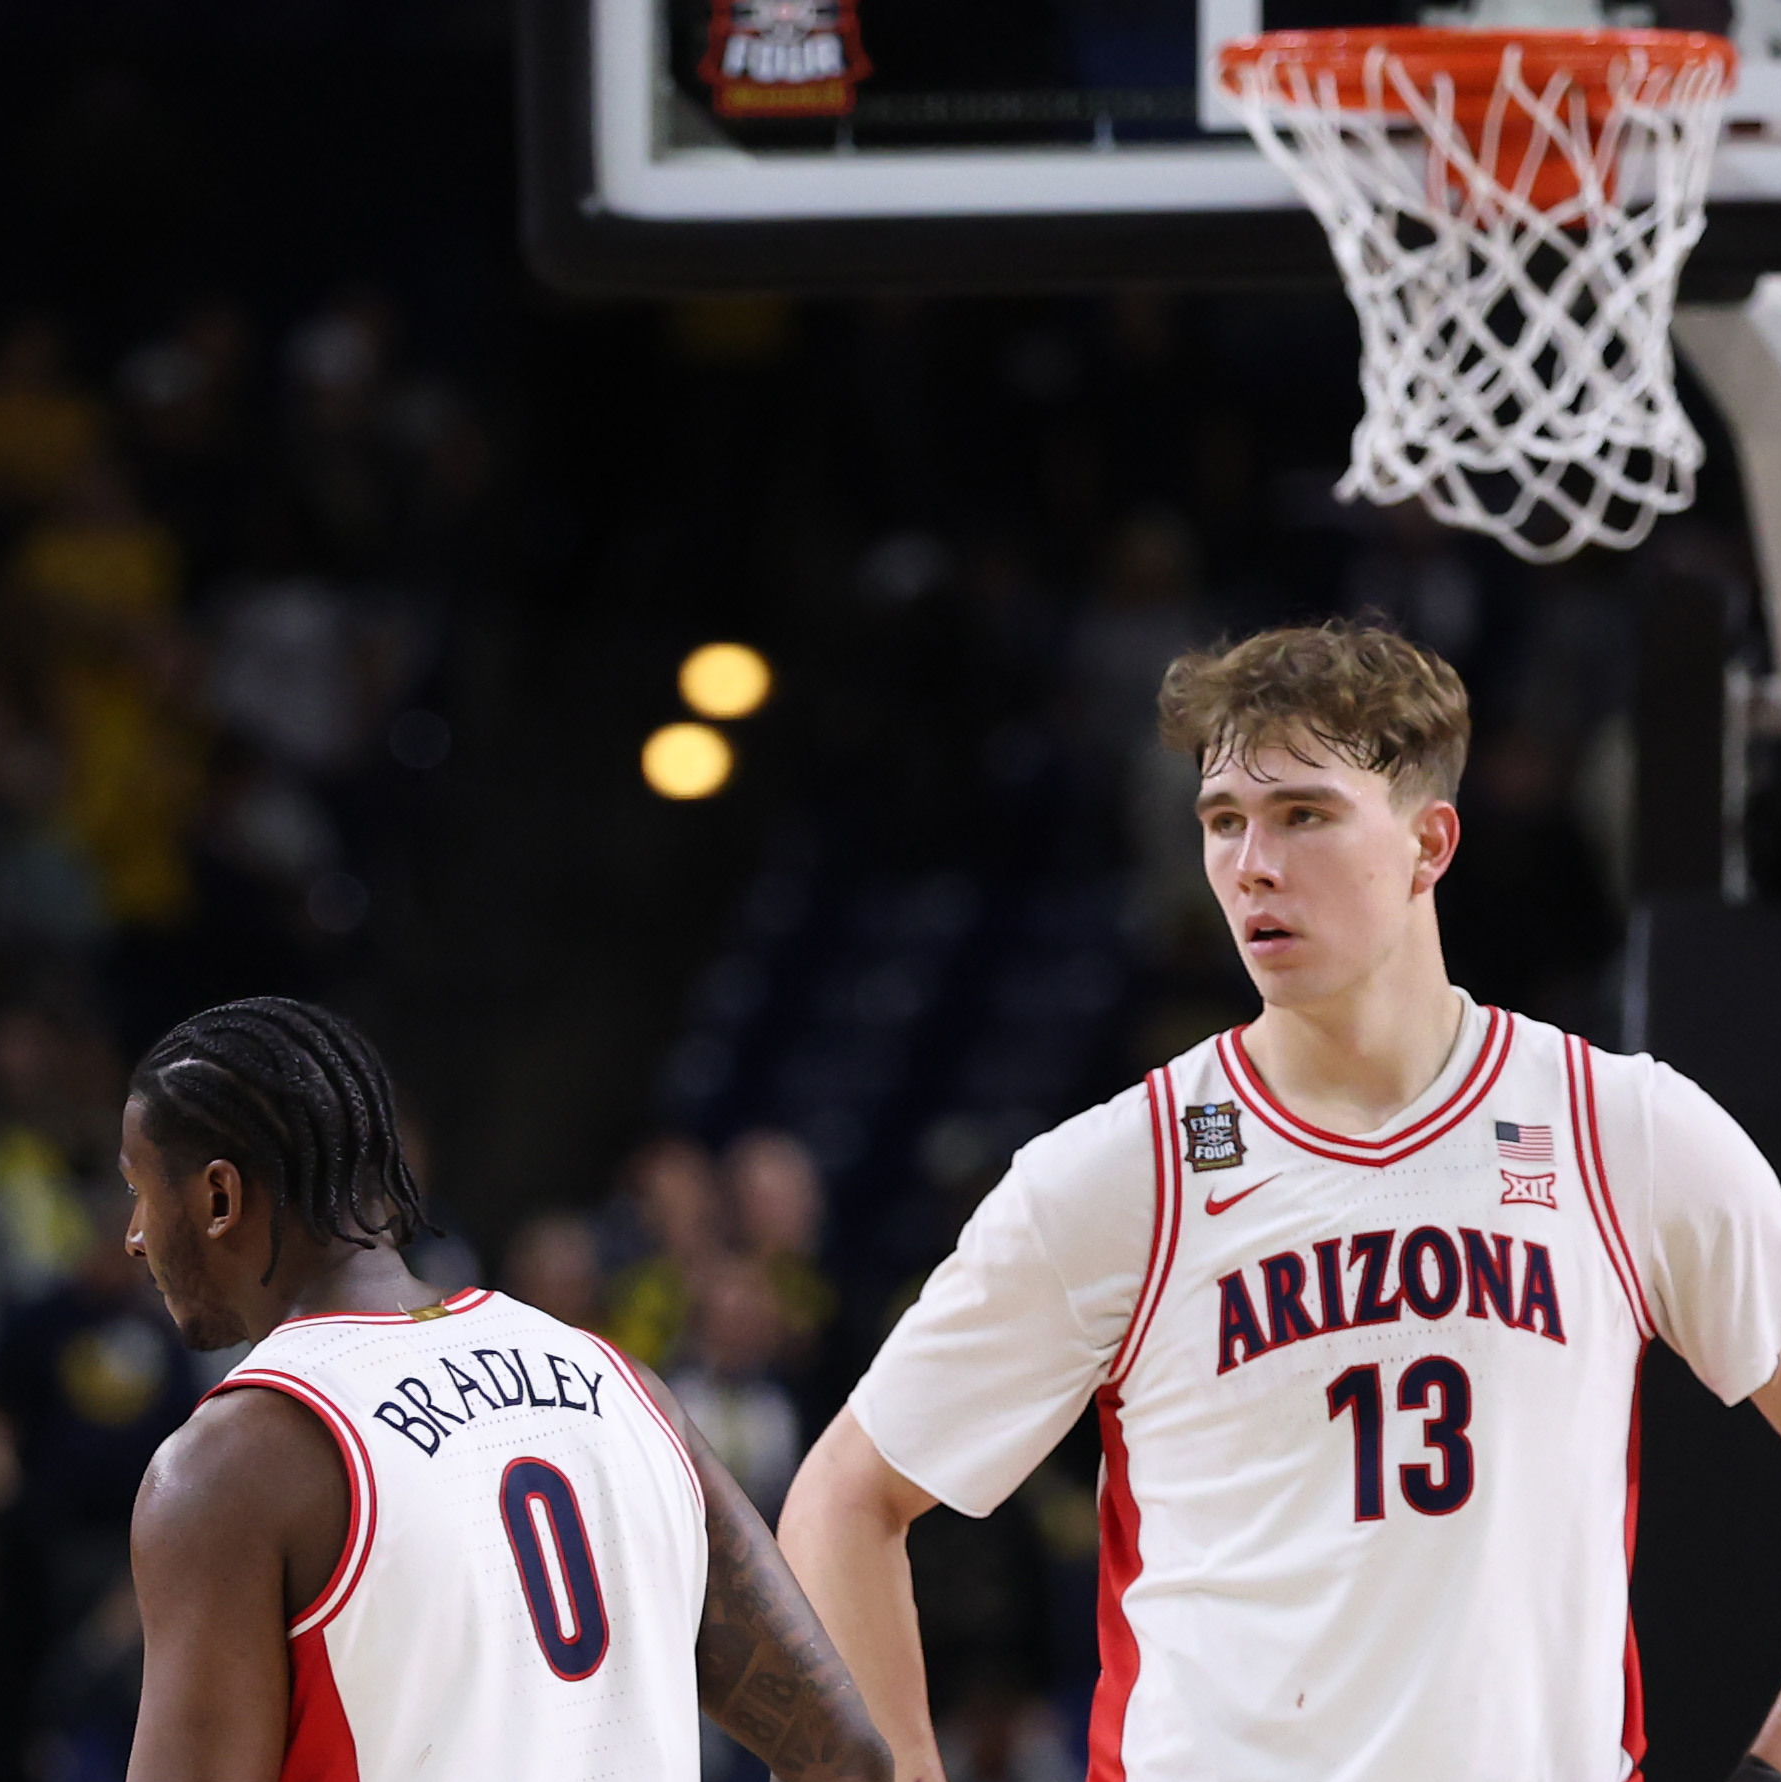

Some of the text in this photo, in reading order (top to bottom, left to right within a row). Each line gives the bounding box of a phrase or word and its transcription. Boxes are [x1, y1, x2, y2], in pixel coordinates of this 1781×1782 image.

[1189, 1113, 1233, 1132] FINAL
[1194, 1141, 1236, 1160] FOUR
[1217, 1225, 1567, 1376] ARIZONA
[373, 1348, 604, 1458] BRADLEY
[1326, 1355, 1474, 1522] 13
[499, 1456, 610, 1682] 0
